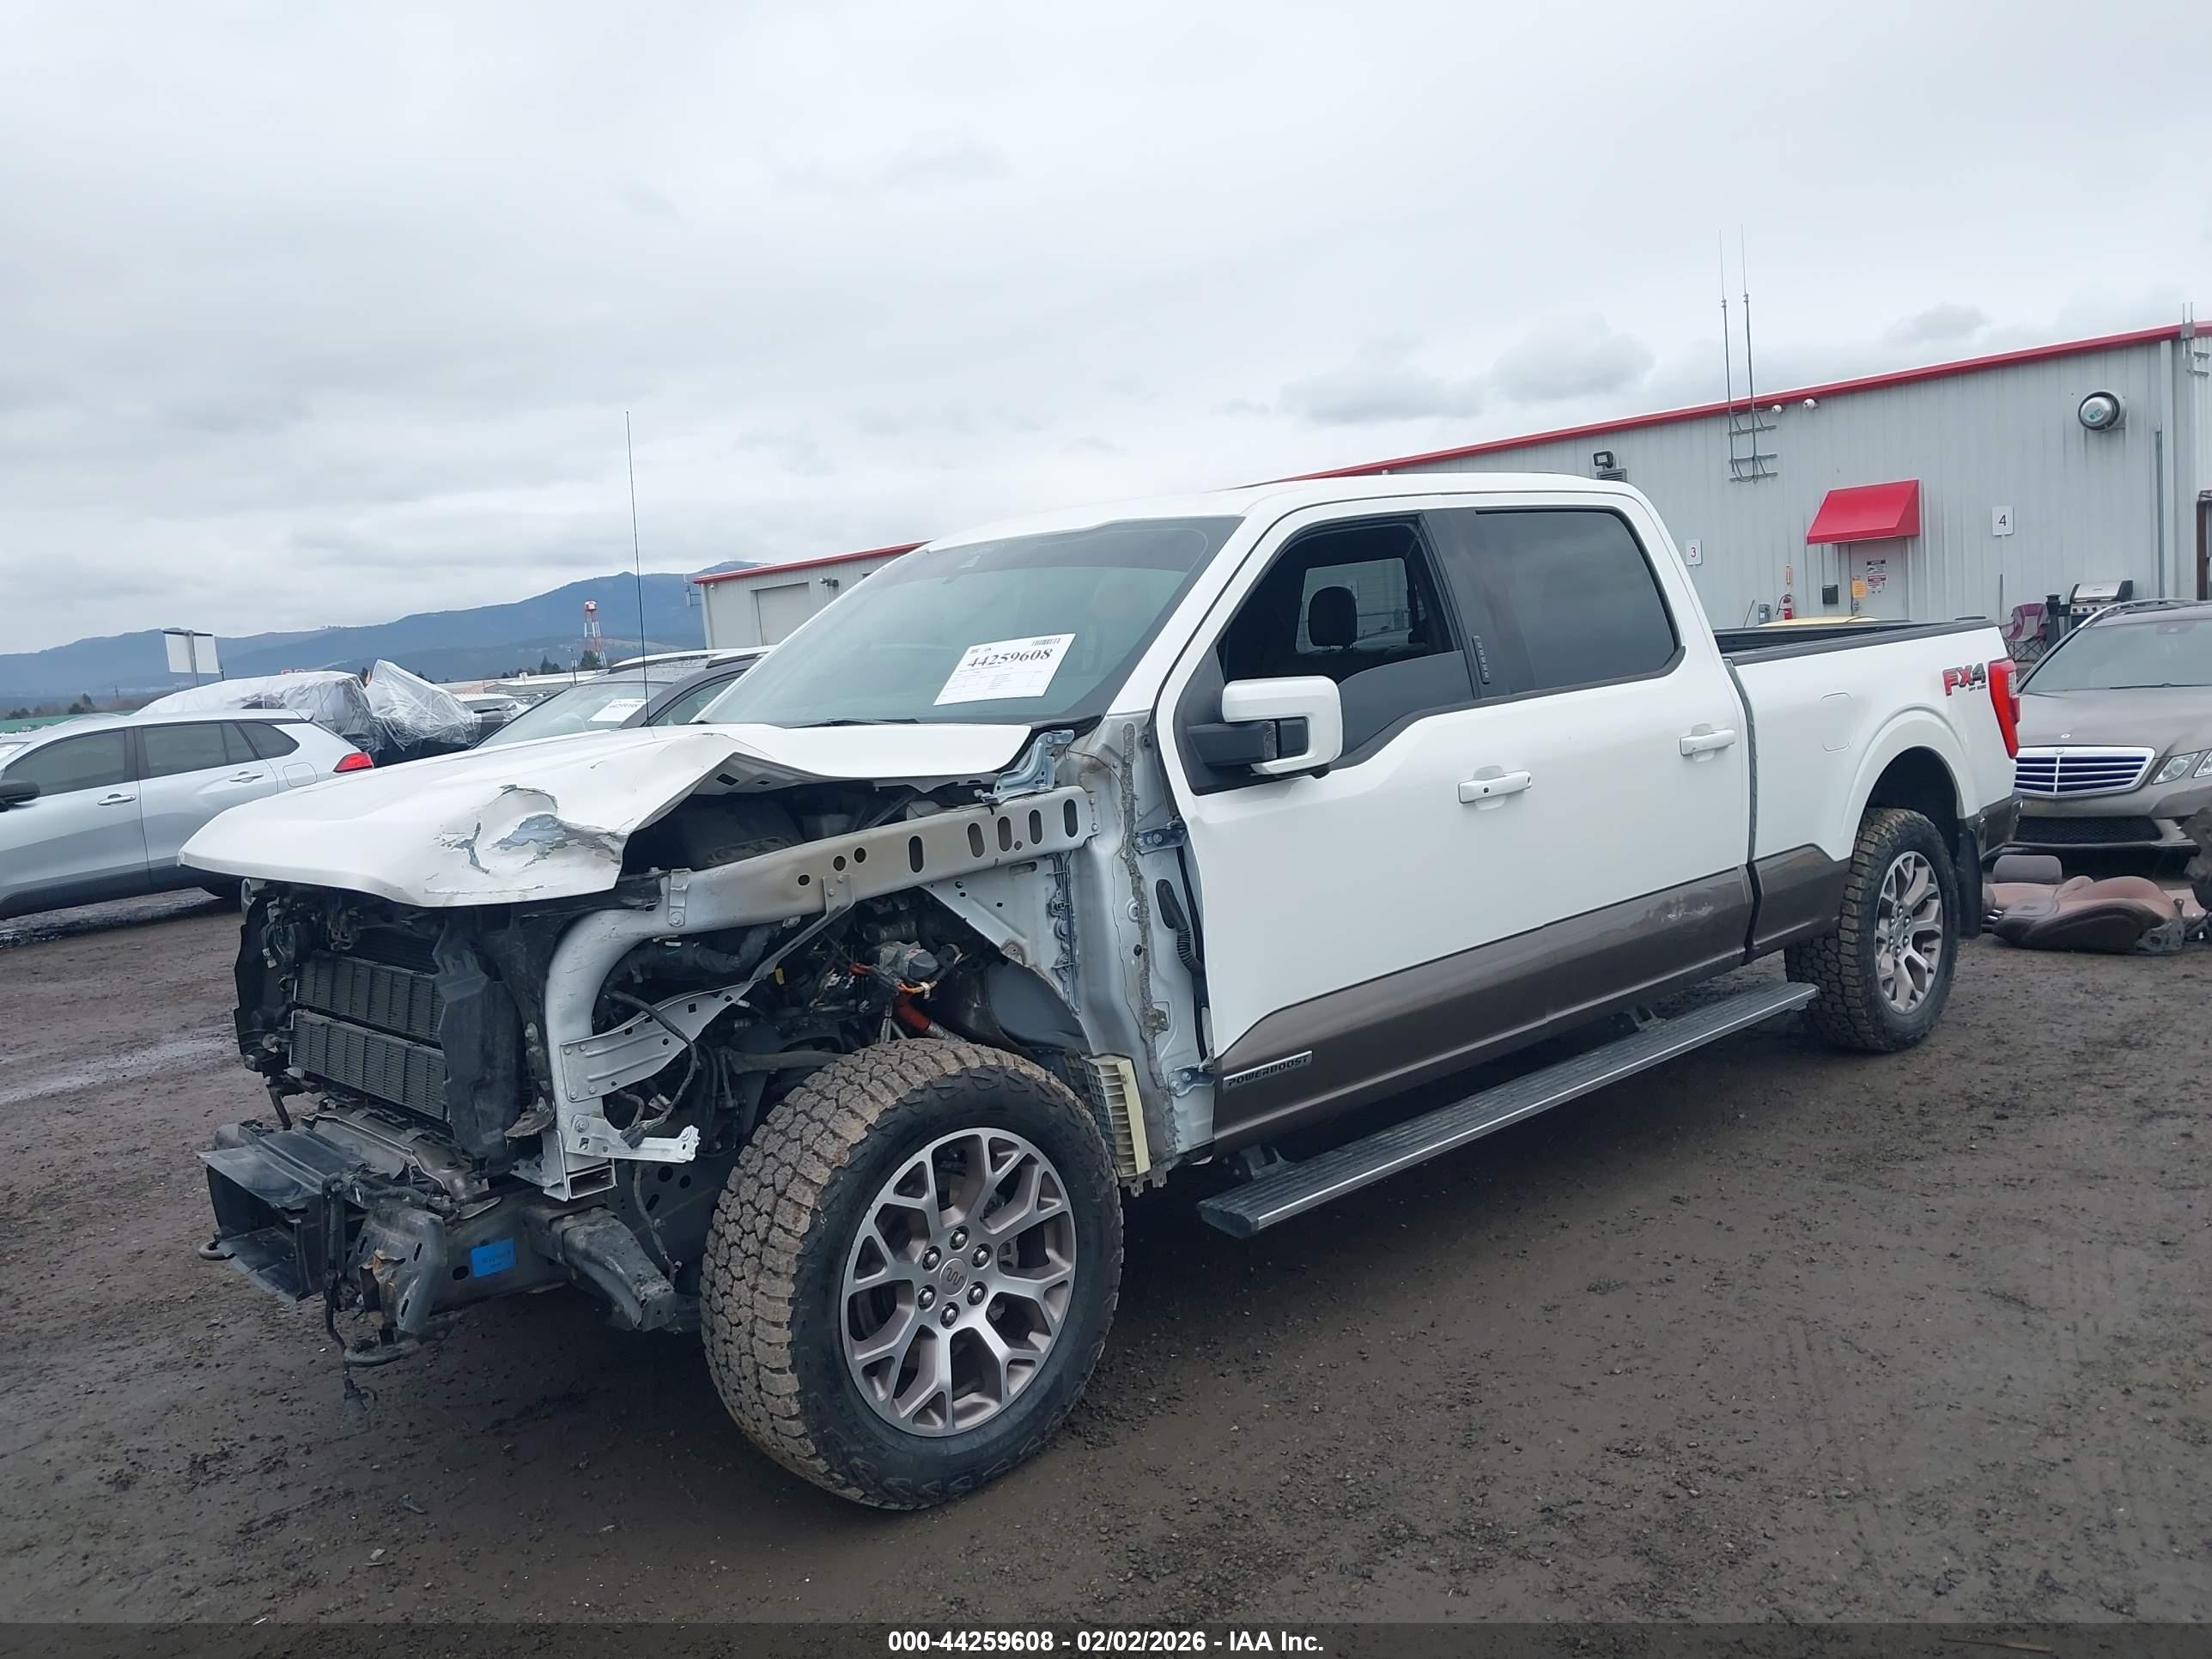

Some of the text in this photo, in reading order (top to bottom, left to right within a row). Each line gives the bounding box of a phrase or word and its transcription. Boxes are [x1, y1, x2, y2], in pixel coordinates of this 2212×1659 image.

[1998, 514, 2007, 526] 4
[1690, 546, 1697, 558] 3
[968, 647, 1054, 667] 44259608
[1942, 662, 1986, 696] FX4
[1228, 1055, 1309, 1086] POWERBOOST
